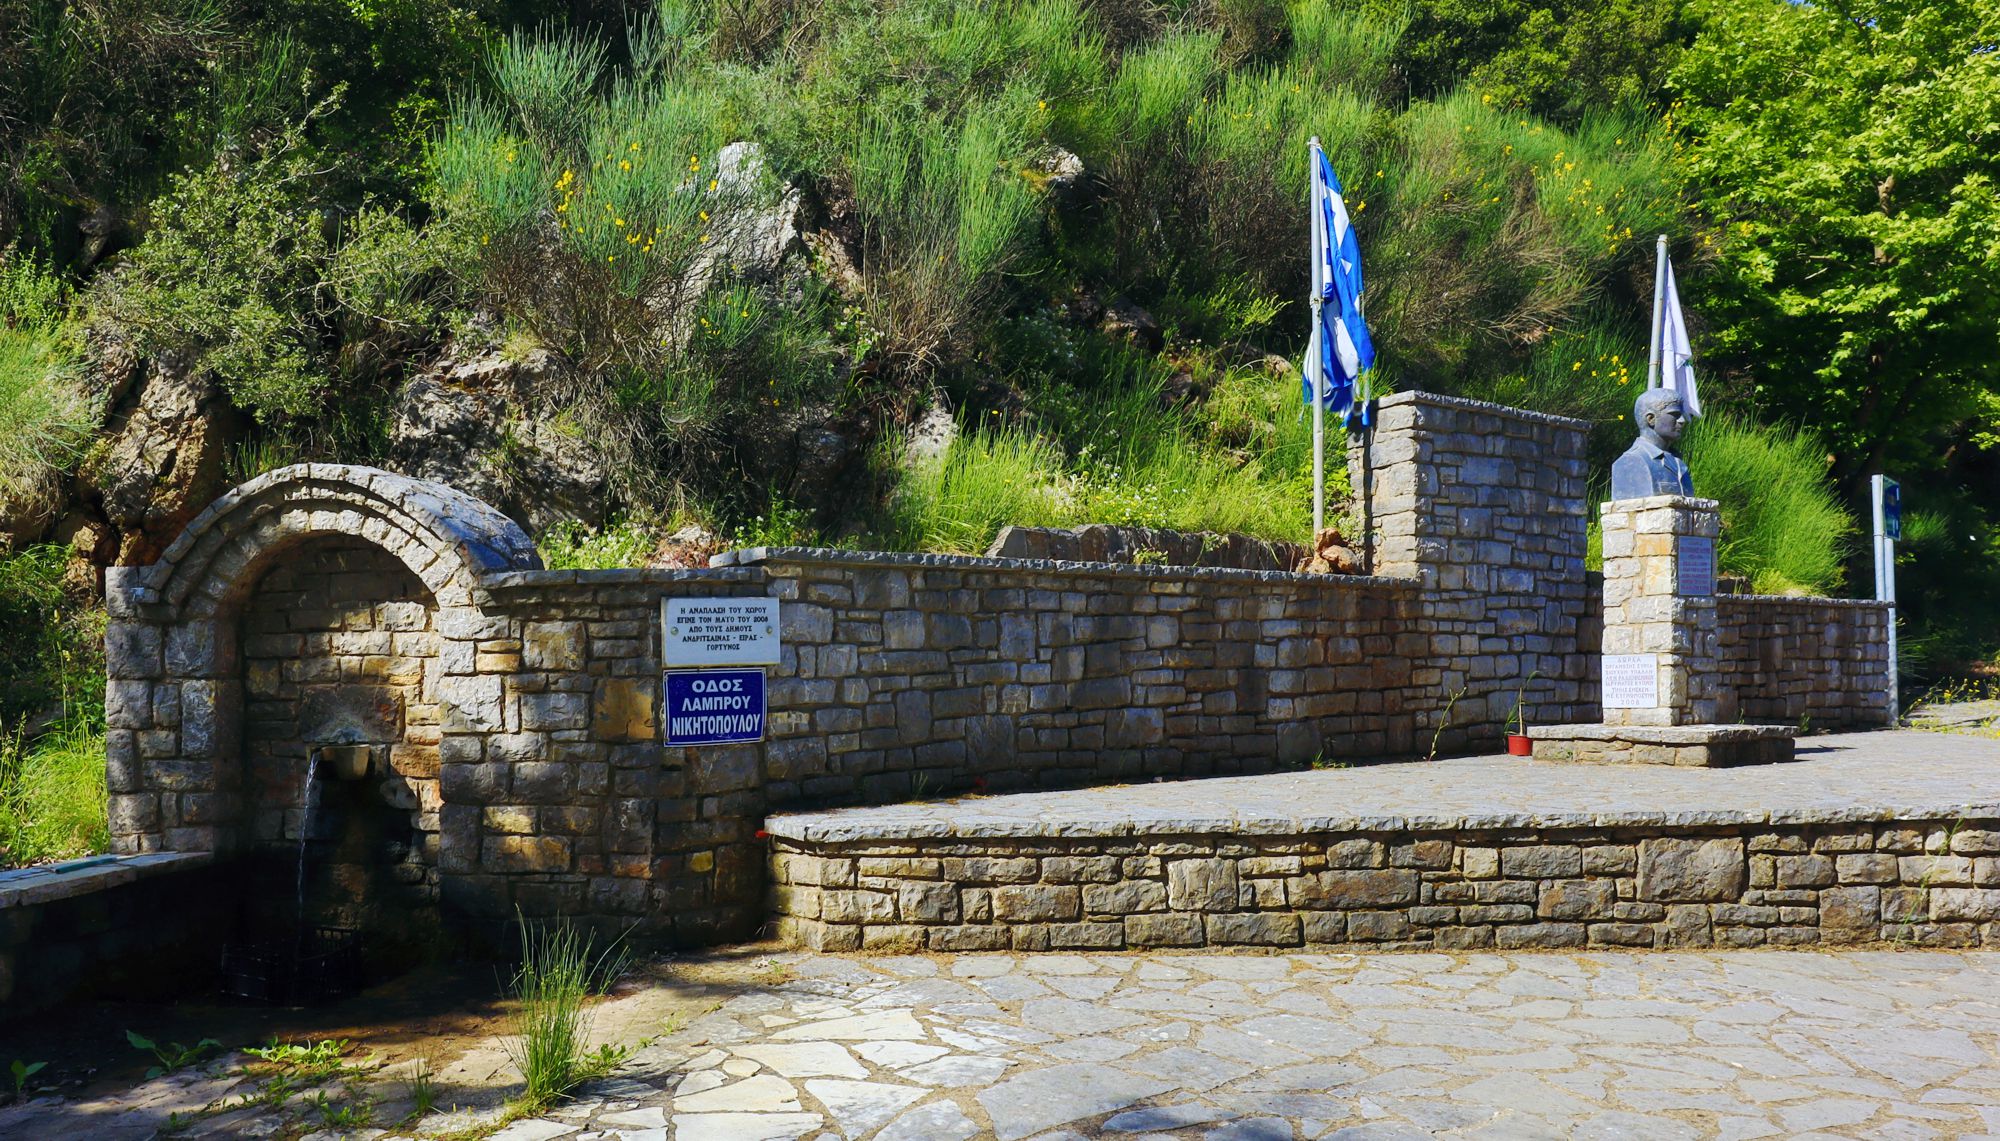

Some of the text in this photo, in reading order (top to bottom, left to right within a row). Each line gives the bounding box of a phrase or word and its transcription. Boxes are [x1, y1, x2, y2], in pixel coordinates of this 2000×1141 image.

[692, 679, 743, 693] ΟΔΟΣ
[682, 696, 751, 711] ΛΑΜΠΡΟΥ
[672, 714, 760, 736] ΝΙΚΗΤΟΠΟΥΛΟΥ
